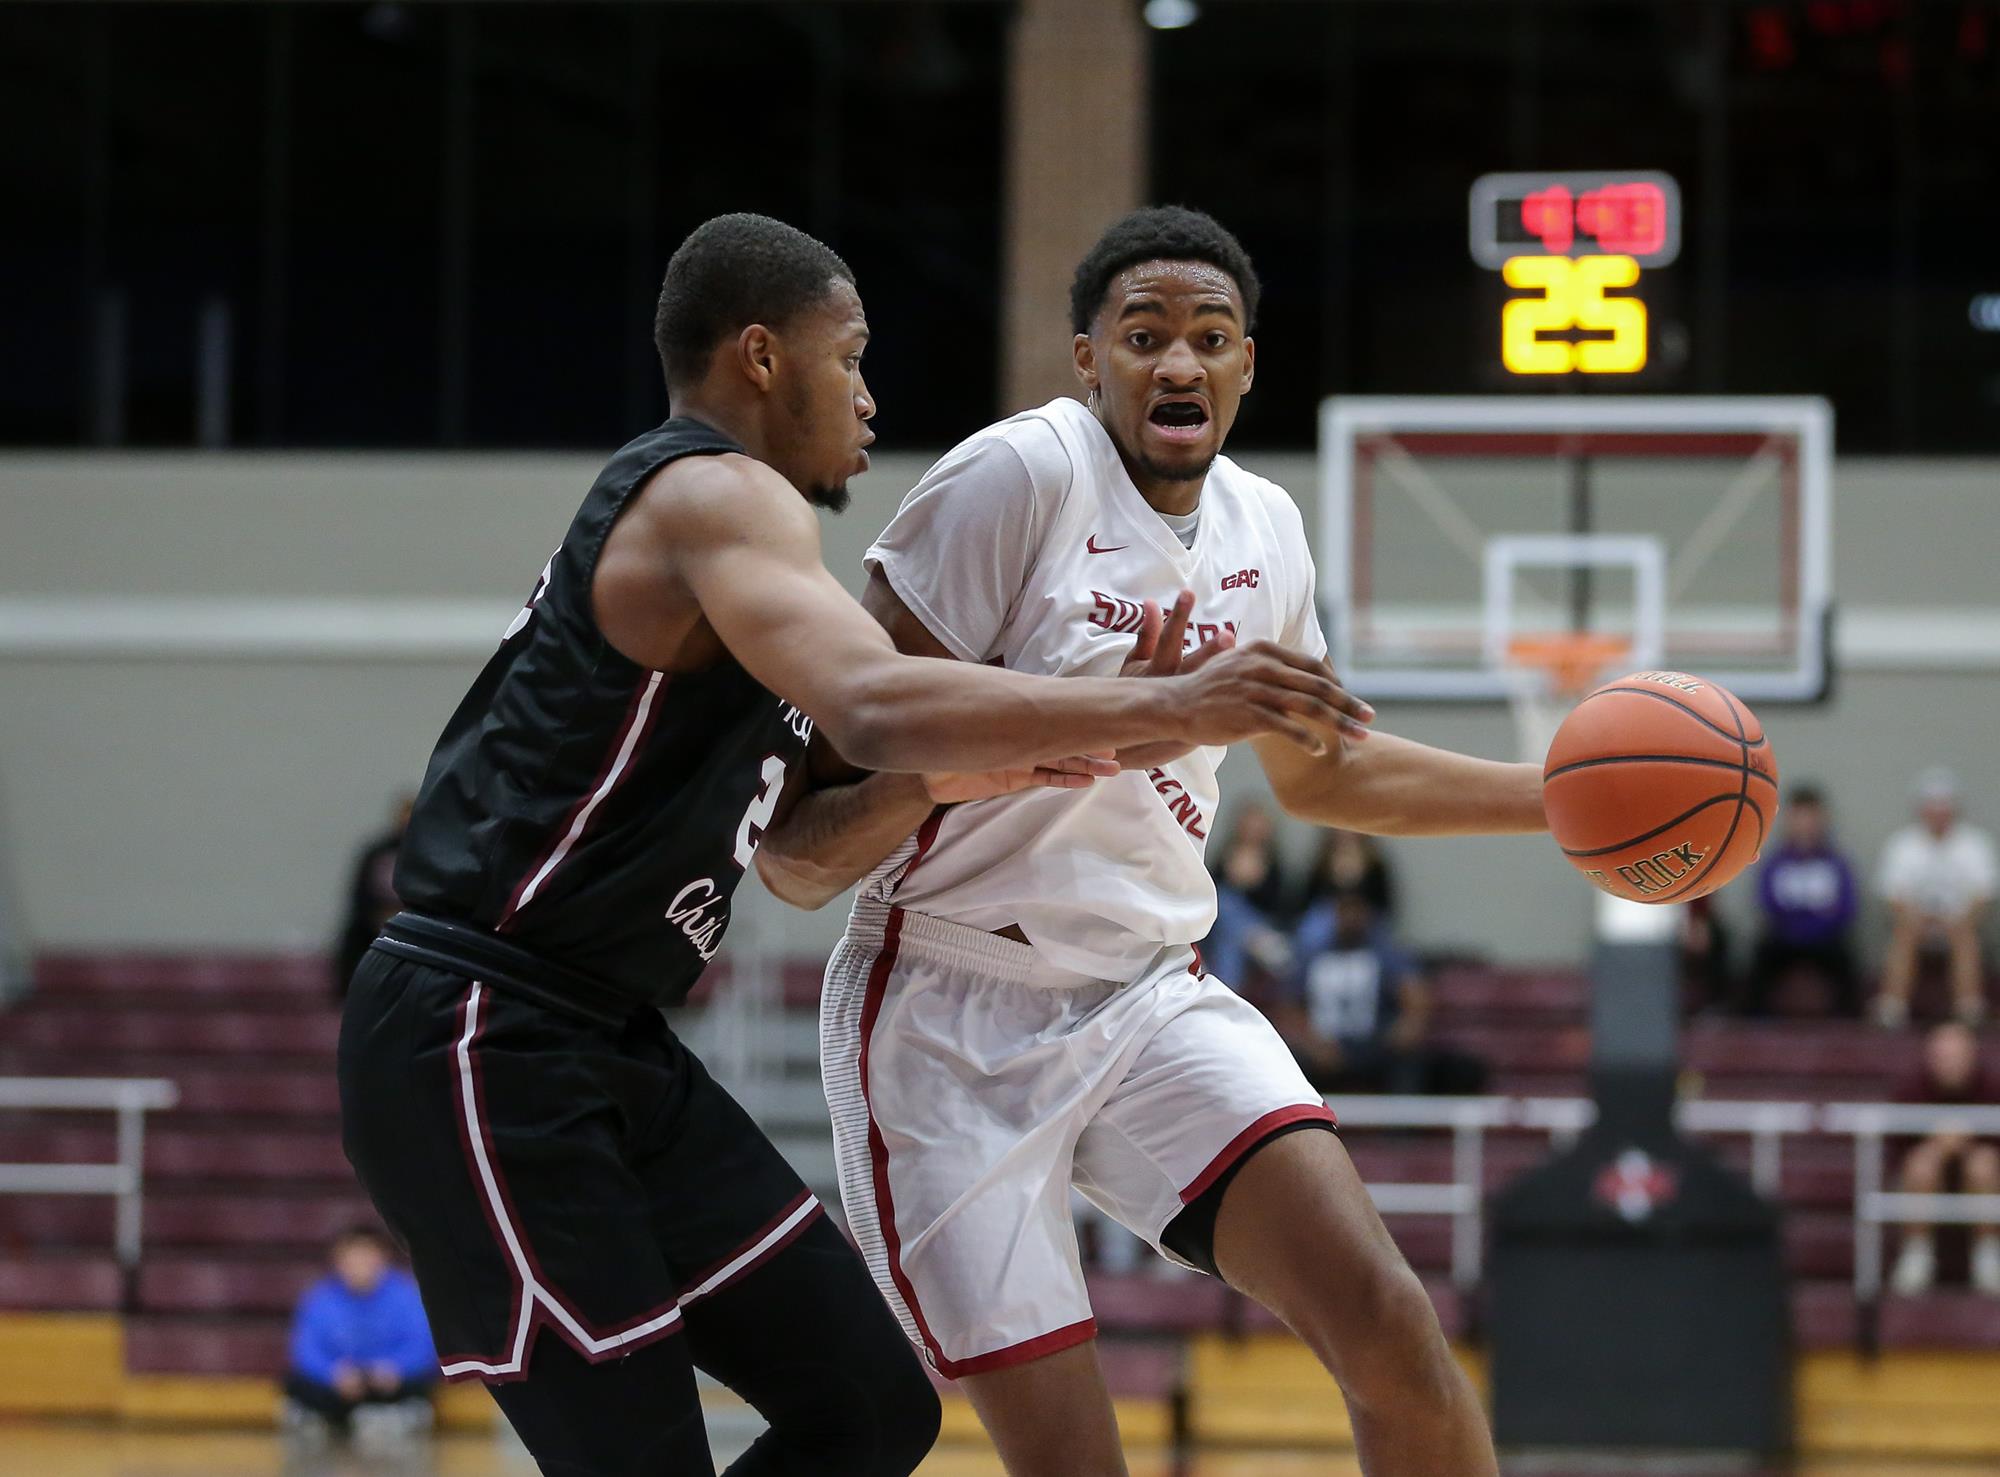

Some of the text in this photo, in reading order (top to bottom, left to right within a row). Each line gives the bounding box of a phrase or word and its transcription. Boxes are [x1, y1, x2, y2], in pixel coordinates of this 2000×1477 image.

[1502, 255, 1648, 374] 25
[1220, 568, 1260, 592] GAC
[1614, 841, 1705, 895] ROCK
